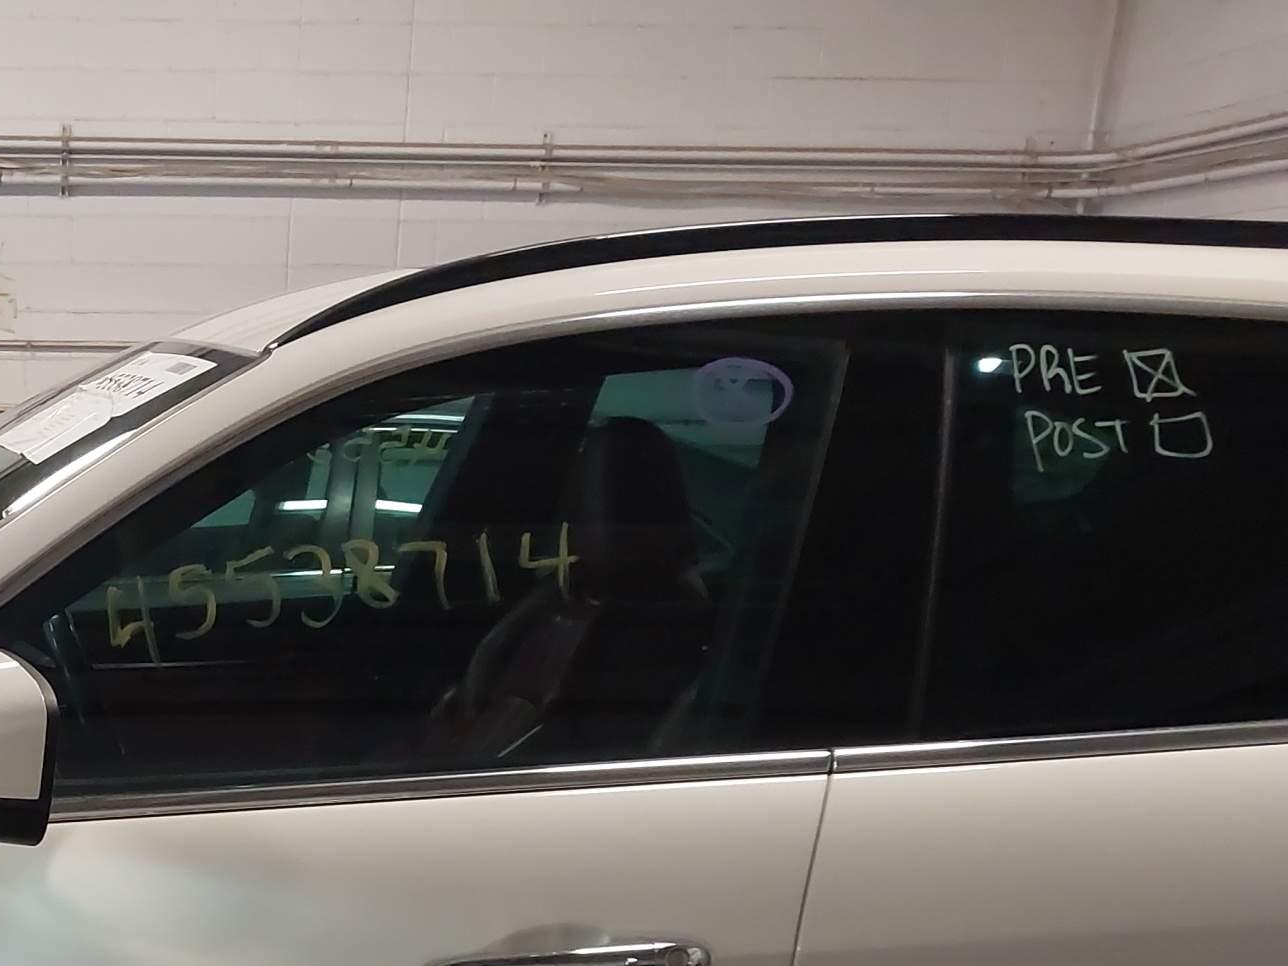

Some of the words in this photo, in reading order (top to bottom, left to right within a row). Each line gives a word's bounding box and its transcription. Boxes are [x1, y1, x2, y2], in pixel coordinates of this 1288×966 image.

[1009, 344, 1103, 394] PRE
[1025, 410, 1129, 472] POST
[107, 521, 579, 667] 45538714
